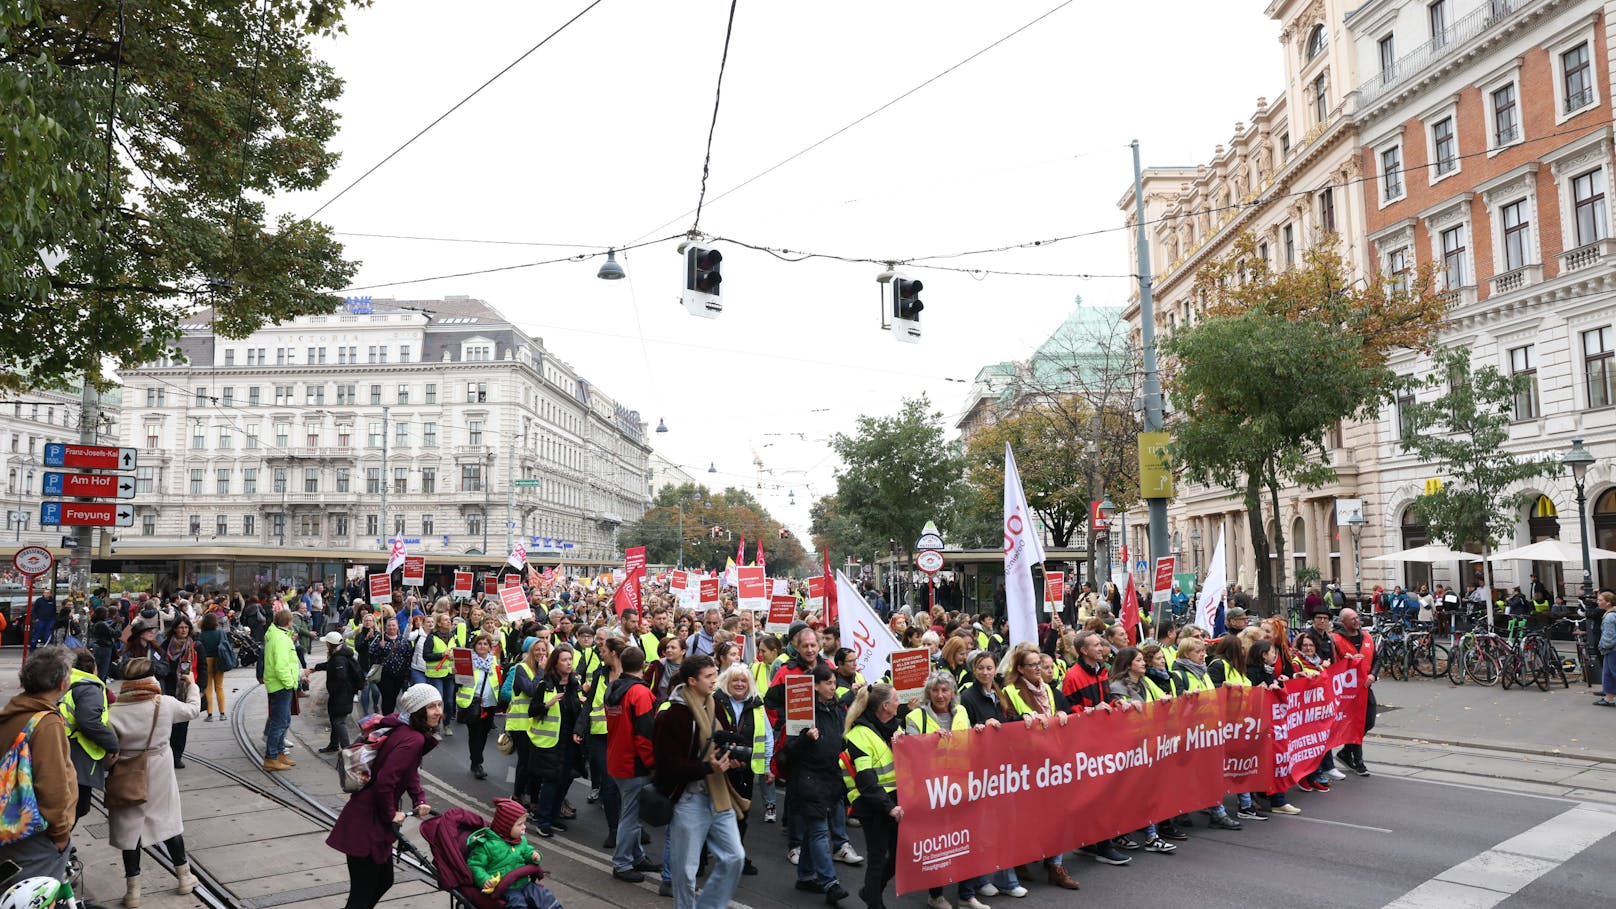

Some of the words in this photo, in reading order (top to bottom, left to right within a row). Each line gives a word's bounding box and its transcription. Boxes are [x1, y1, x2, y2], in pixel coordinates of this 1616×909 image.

[65, 447, 119, 457] Franz-Josefs-Kai
[71, 475, 89, 485] Am
[91, 475, 111, 486] Hof
[66, 509, 111, 521] Freyung
[892, 654, 923, 664] AUFWERTUNG
[1303, 686, 1326, 705] WIR
[925, 775, 963, 810] Wo
[967, 763, 1031, 802] bleibt
[1035, 758, 1073, 788] das
[1075, 738, 1153, 781] Personal,
[1156, 734, 1181, 761] Herr
[912, 829, 970, 863] younion
